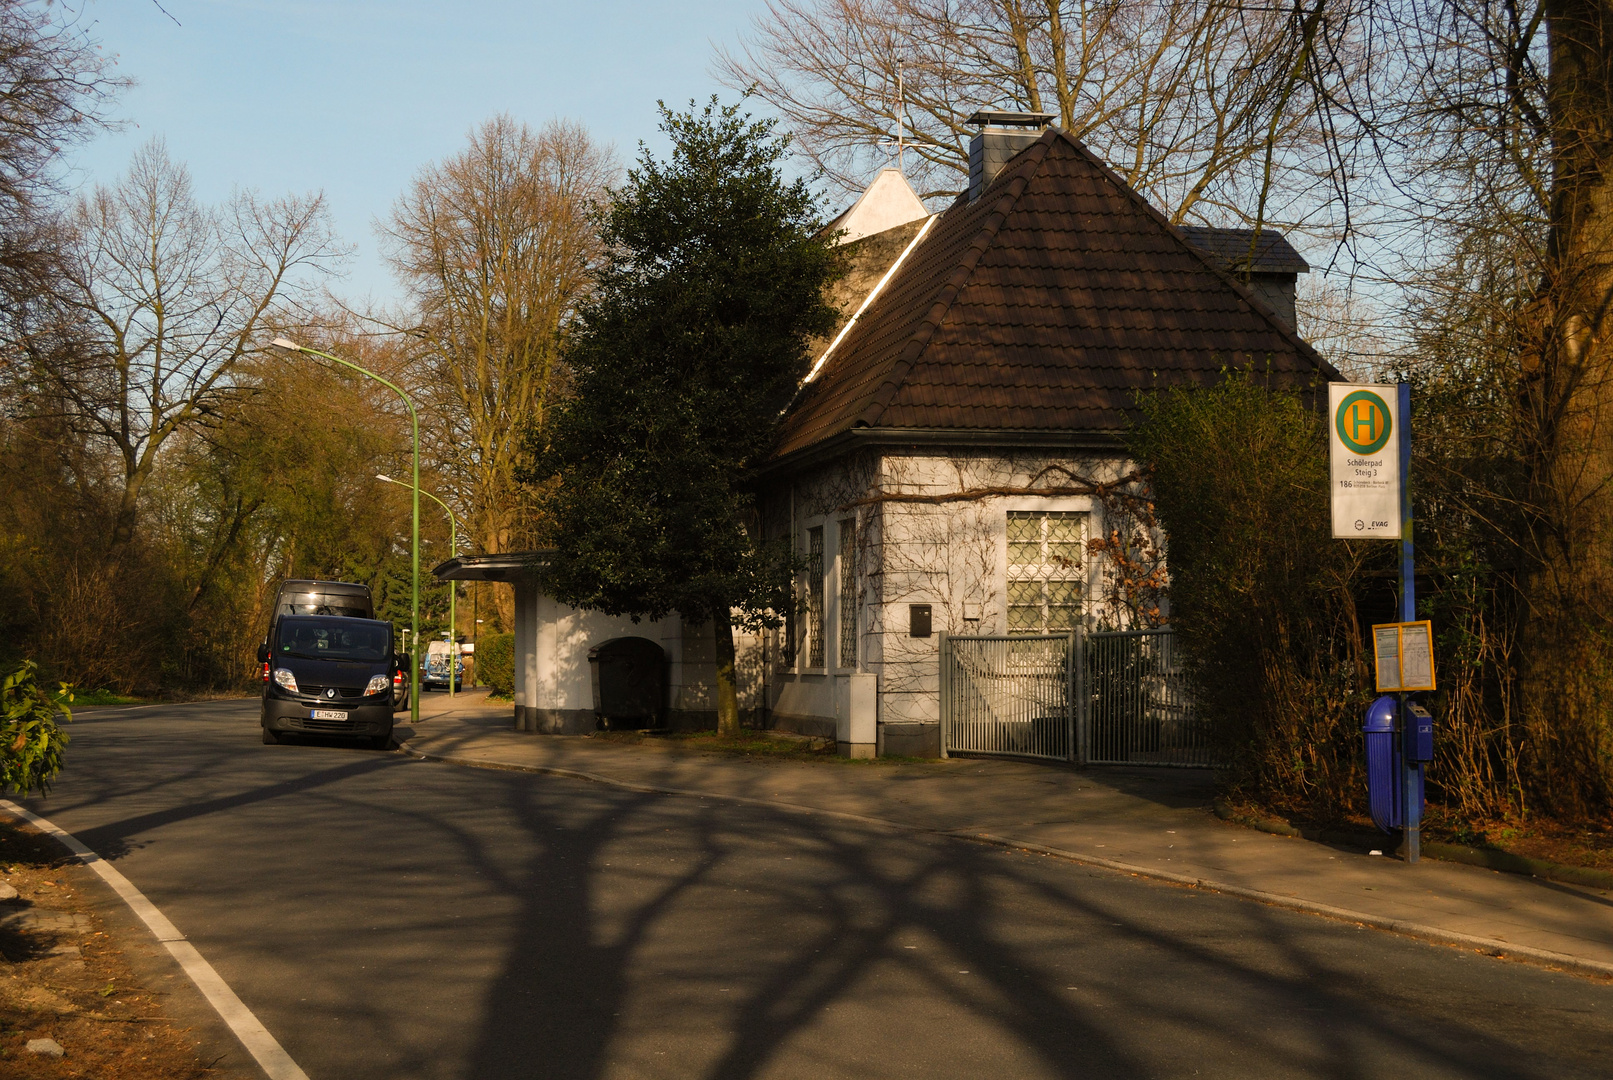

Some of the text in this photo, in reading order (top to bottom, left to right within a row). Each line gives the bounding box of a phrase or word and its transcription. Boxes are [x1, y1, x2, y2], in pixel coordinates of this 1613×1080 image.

[1353, 405, 1375, 440] H
[1347, 459, 1382, 468] Schölerpad
[1355, 469, 1378, 478] Steig 3
[1340, 480, 1352, 488] 186
